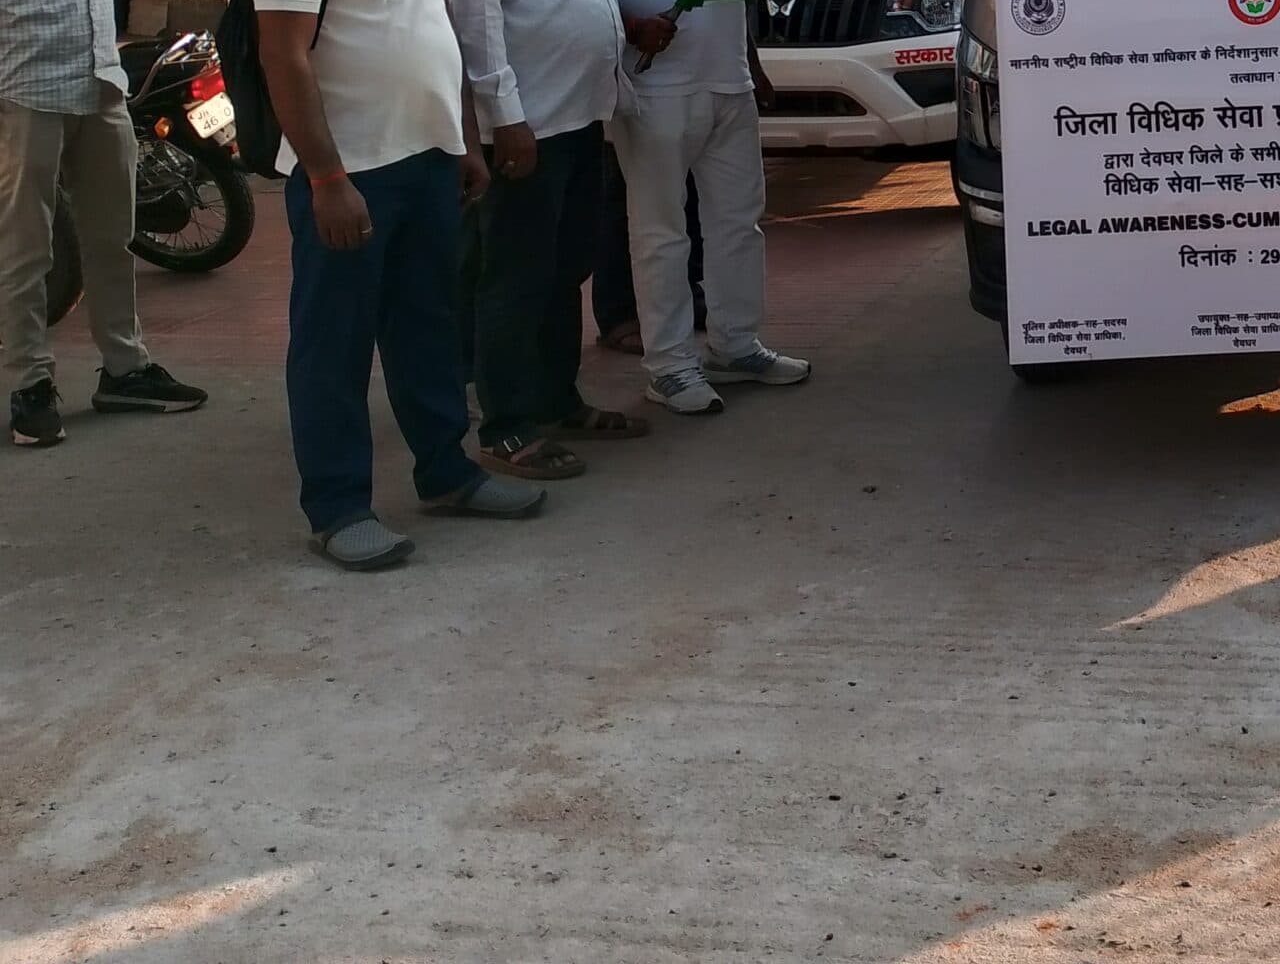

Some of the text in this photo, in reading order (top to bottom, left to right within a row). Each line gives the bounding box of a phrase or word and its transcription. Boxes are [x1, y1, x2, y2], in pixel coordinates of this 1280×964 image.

[895, 47, 955, 64] सरकार
[1009, 55, 1049, 70] माननीय
[1053, 53, 1087, 69] राष्ट्रीय
[1090, 52, 1124, 67] विधिक
[1127, 50, 1149, 65] सेवा
[1152, 49, 1197, 63] प्राधिकार
[1199, 46, 1212, 61] के
[1215, 44, 1279, 62] निर्देशानुसार
[1054, 106, 1117, 136] जिला
[1127, 101, 1205, 134] विधिक
[1213, 98, 1263, 129] सेवा
[1103, 153, 1134, 170] द्वारा
[1140, 147, 1184, 167] देवघर
[1188, 144, 1223, 165] जिले
[1229, 143, 1245, 162] के
[1250, 141, 1280, 161] सभी
[1103, 172, 1160, 196] विधिक
[1027, 219, 1092, 237] LEGAL
[1178, 244, 1237, 267] दिनांक
[1022, 321, 1045, 335] पुलिस
[1024, 334, 1046, 345] जिला
[1076, 331, 1092, 341] सेवा
[1191, 325, 1212, 336] जिला
